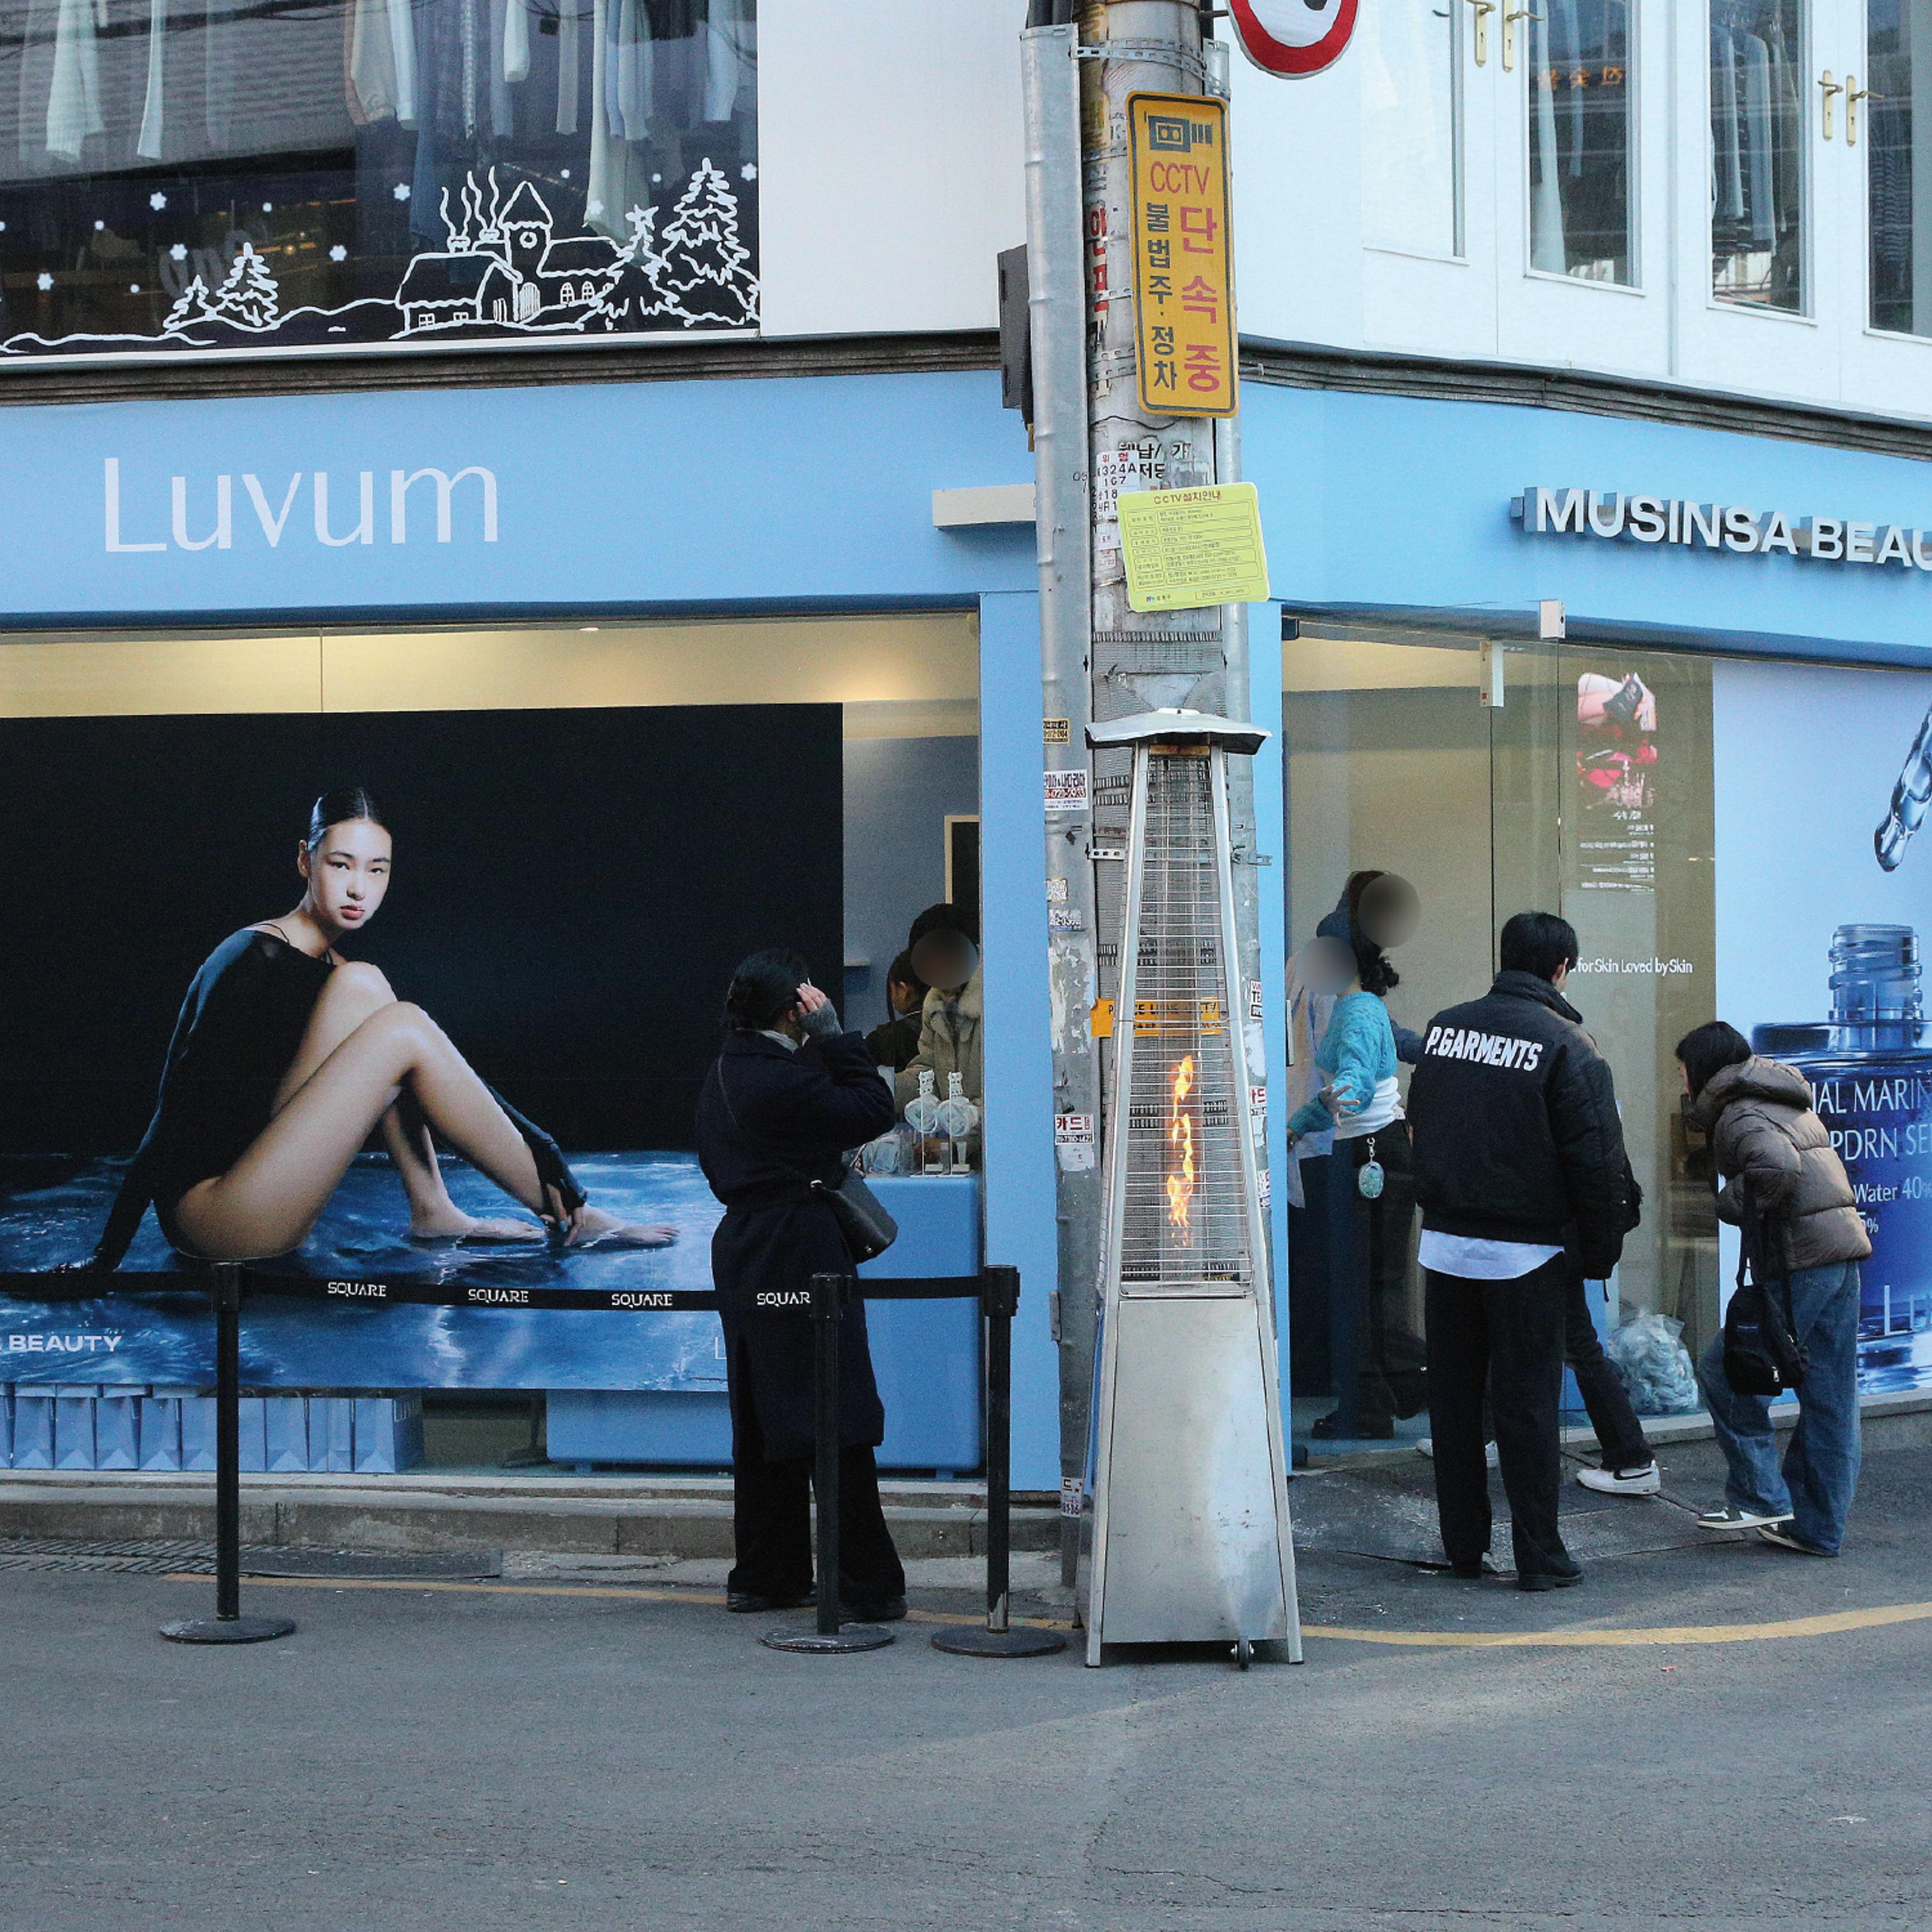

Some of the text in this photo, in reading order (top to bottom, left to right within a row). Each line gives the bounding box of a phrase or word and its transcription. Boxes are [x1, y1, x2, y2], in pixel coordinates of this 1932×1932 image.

[1150, 160, 1211, 195] CCTV
[1180, 205, 1221, 392] 단속중
[104, 456, 498, 552] Luvum
[1154, 490, 1222, 505] CCTV설치안내
[1524, 487, 1799, 555] MUSINSA
[1578, 957, 1693, 977] for Skin Loved by Skin
[1424, 1026, 1543, 1072] P.GARMENTS
[1056, 1116, 1083, 1131] 카드
[1830, 1123, 1932, 1160] PDRN SE
[1854, 1183, 1898, 1204] Water
[328, 1281, 387, 1297] SQUARE
[468, 1289, 529, 1304] SQUARE
[611, 1294, 673, 1308] SQUARE
[757, 1292, 811, 1307] SQUAR
[9, 1334, 122, 1352] BEAUTY
